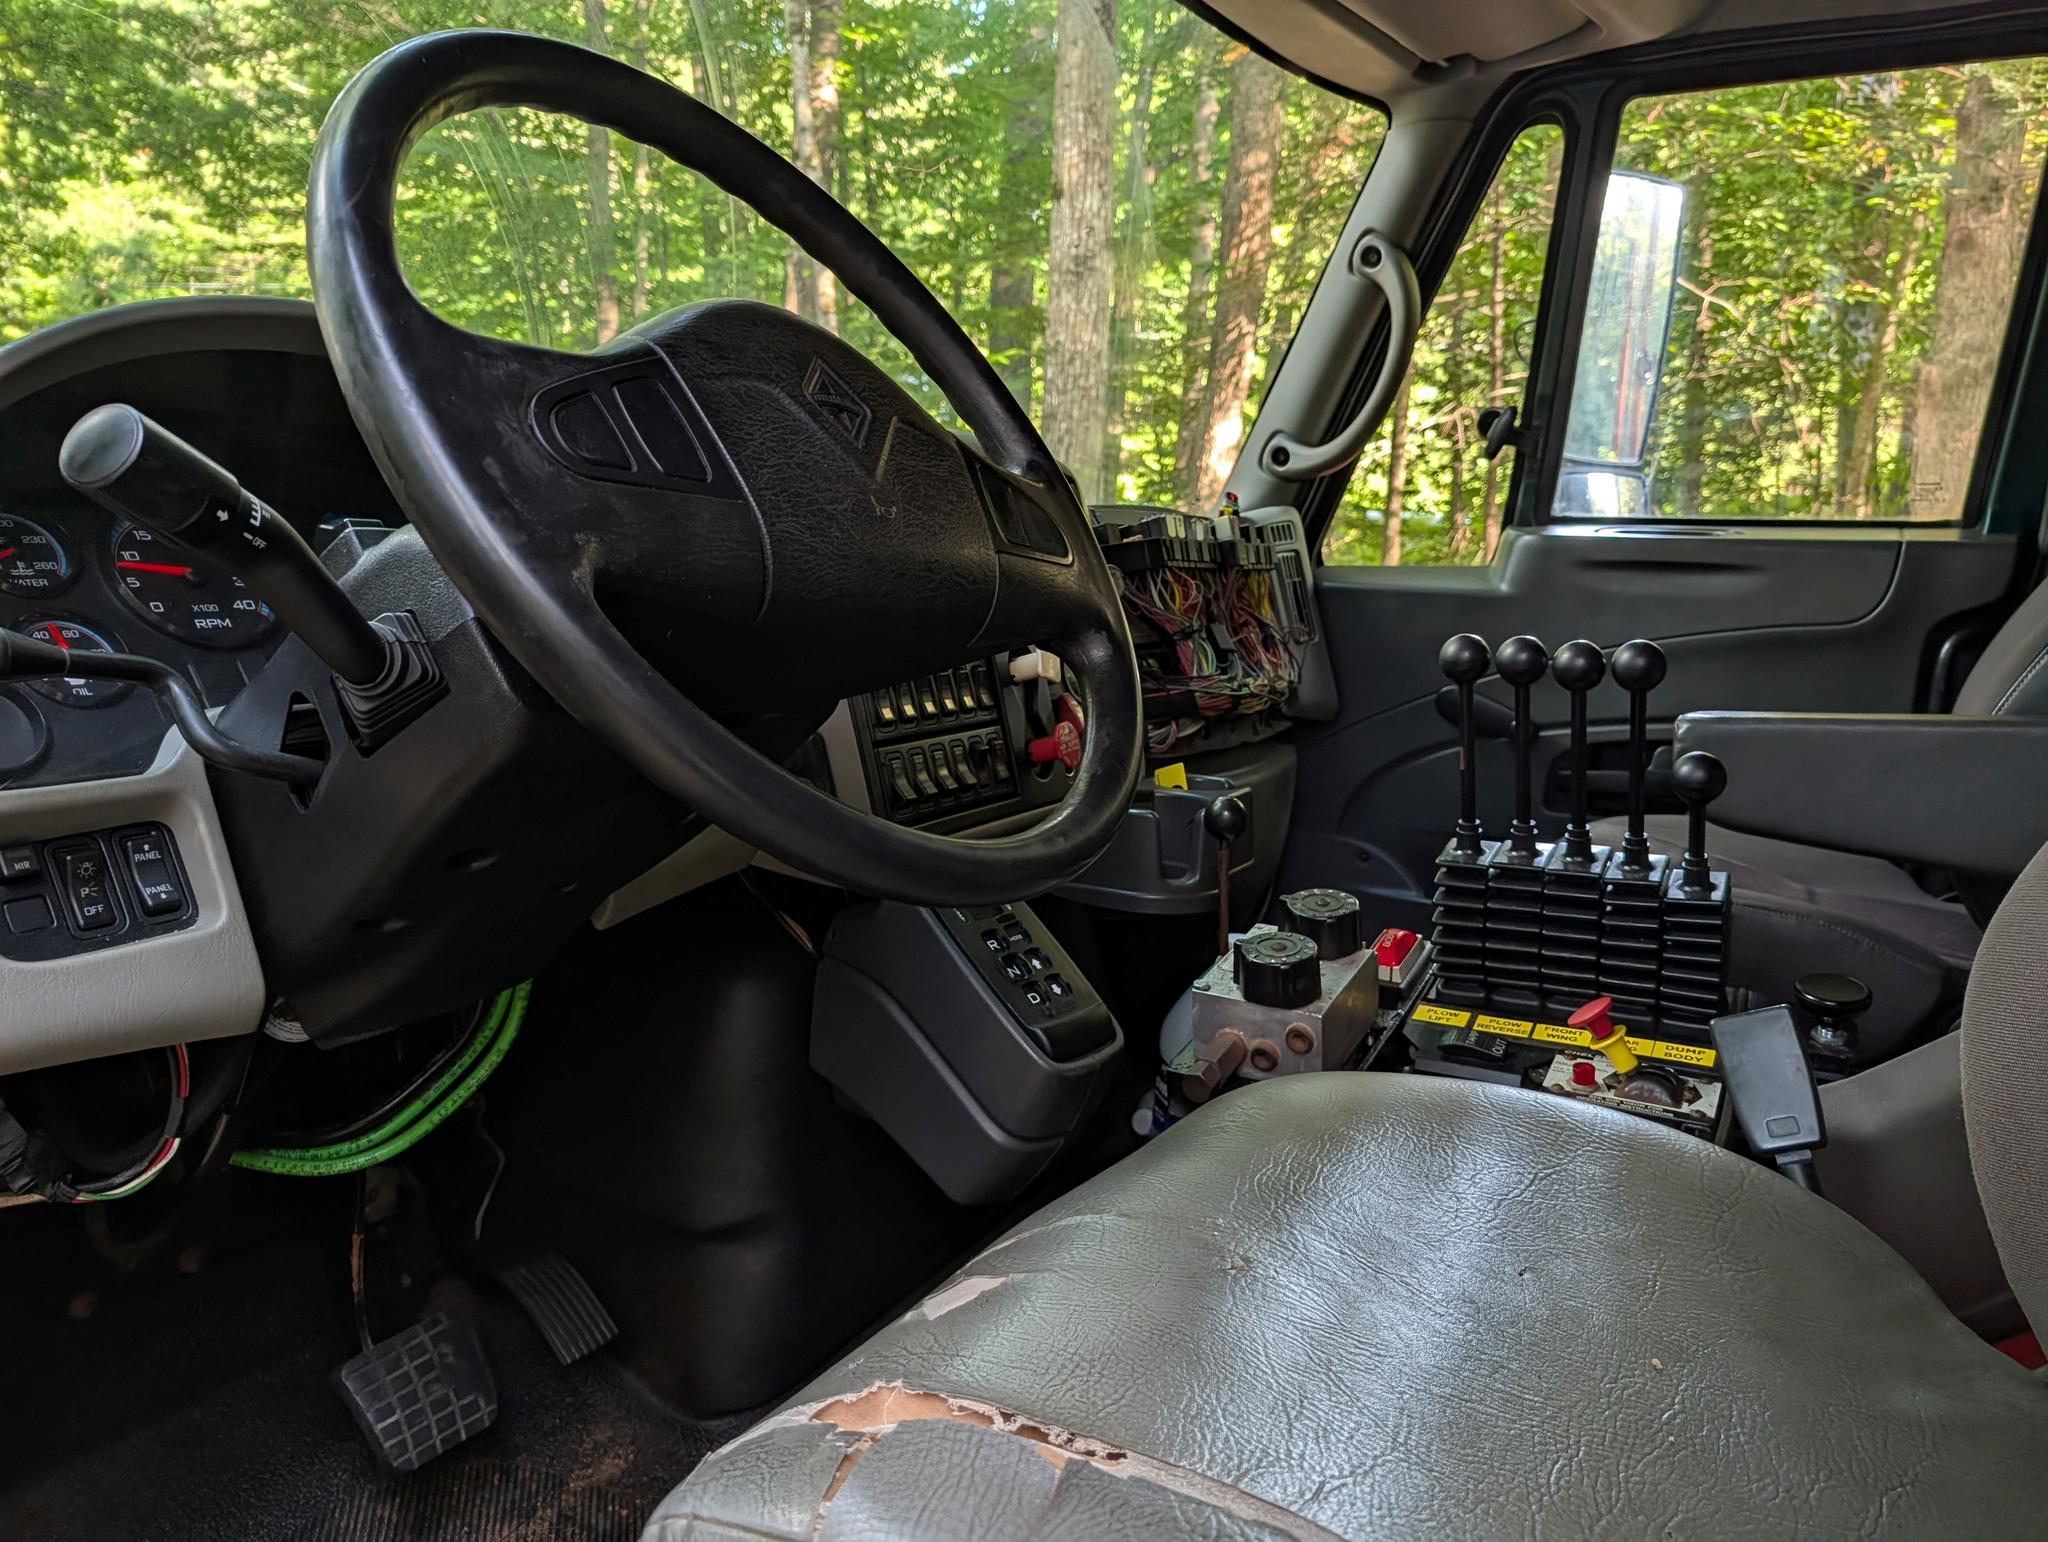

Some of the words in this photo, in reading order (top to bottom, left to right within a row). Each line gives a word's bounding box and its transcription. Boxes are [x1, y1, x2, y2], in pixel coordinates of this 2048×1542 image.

[20, 535, 46, 544] 230
[132, 529, 152, 541] 15
[252, 536, 268, 549] OFF
[120, 550, 140, 561] 10
[32, 561, 58, 570] 260
[9, 578, 48, 587] ATER
[126, 576, 140, 588] 5
[149, 601, 164, 613] 0
[232, 599, 256, 611] 40
[194, 617, 233, 630] RPM
[32, 630, 49, 639] 40
[62, 629, 80, 638] 60
[134, 850, 161, 862] PANEL
[145, 883, 174, 895] PANEL
[84, 904, 104, 916] OFF
[986, 939, 1001, 951] R
[1007, 965, 1021, 979] N
[1027, 992, 1041, 1005] D
[1426, 1008, 1460, 1018] PLOW
[1428, 1015, 1454, 1023] LIFT
[1488, 1018, 1522, 1028] PLOW
[1476, 1023, 1529, 1036] REVERSE
[1544, 1026, 1585, 1037] FRONT
[1546, 1032, 1578, 1042] WING
[1492, 1038, 1508, 1055] OUT
[1665, 1045, 1707, 1055] DUMP
[1663, 1051, 1704, 1063] BODY
